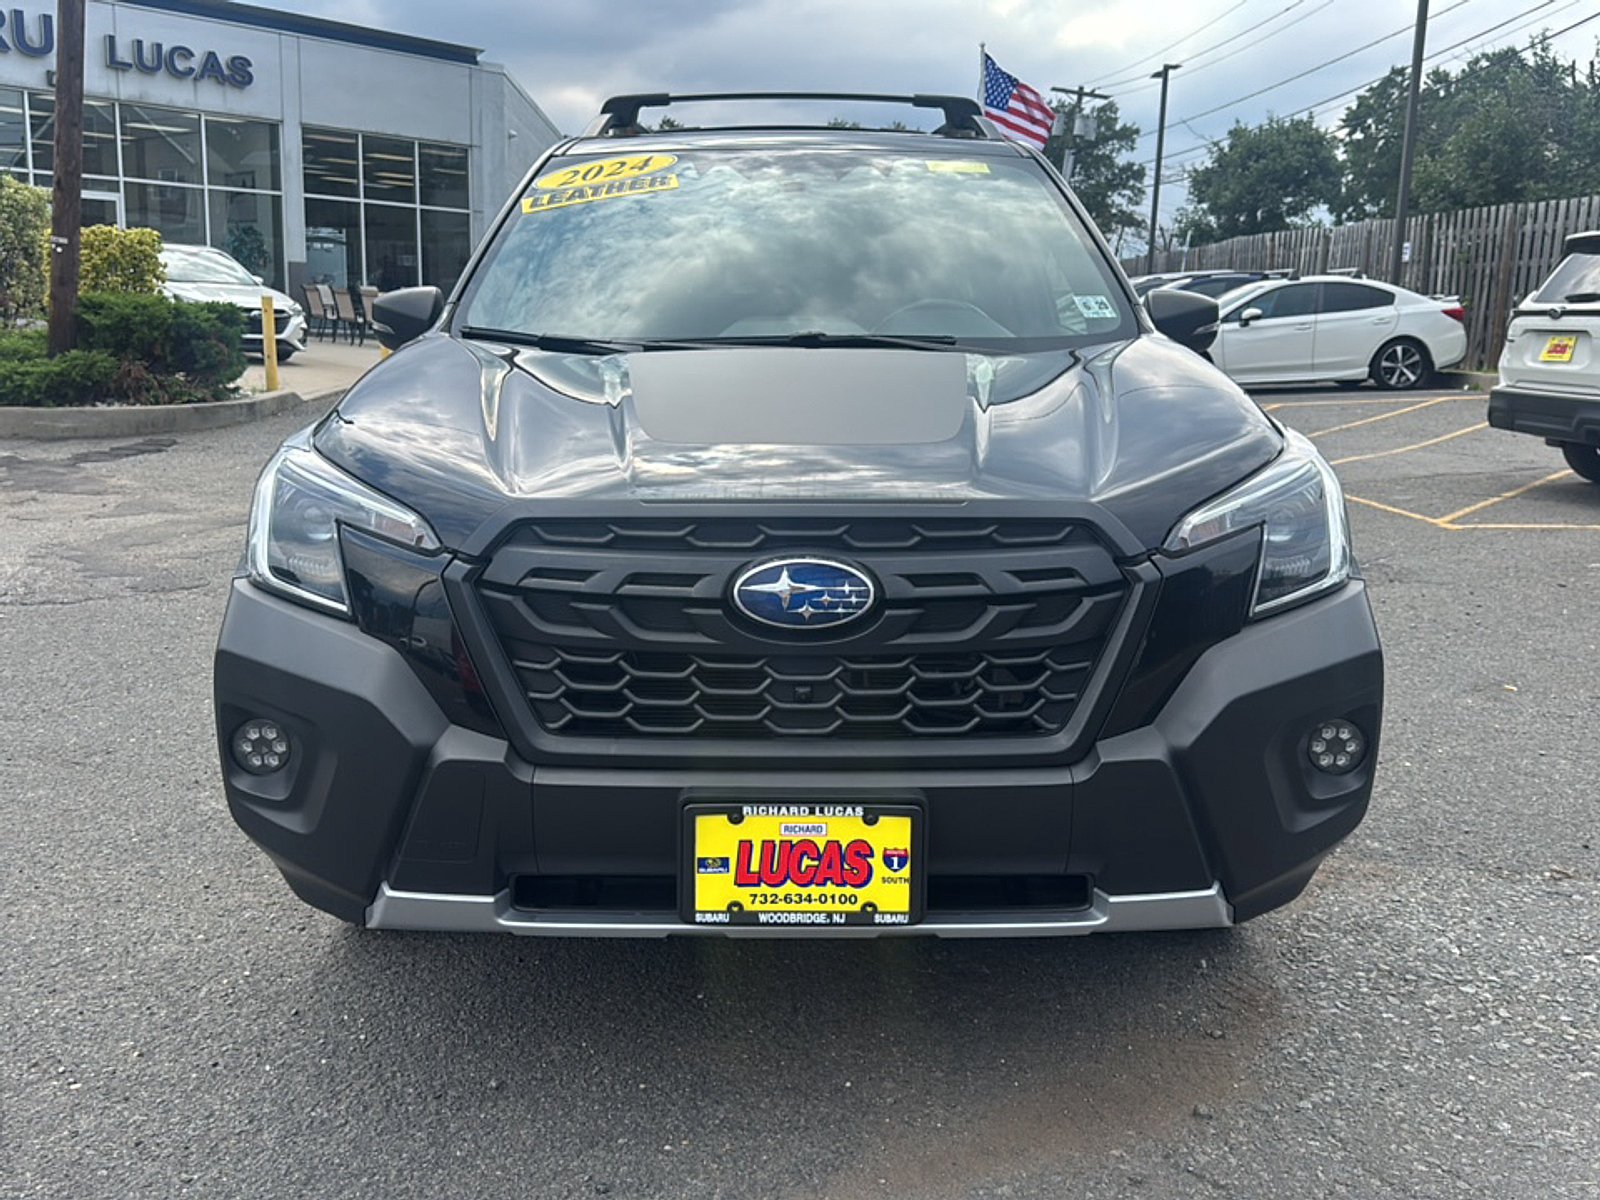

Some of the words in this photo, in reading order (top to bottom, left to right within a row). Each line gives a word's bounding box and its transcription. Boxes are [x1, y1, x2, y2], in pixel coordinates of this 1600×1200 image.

[104, 34, 254, 89] LUCAS
[559, 155, 654, 187] 2024
[529, 176, 672, 209] LEATHER
[742, 806, 810, 816] RICHARD
[815, 806, 865, 817] LUCAS
[783, 825, 824, 834] RICHARD
[734, 839, 875, 888] LUCAS
[890, 856, 900, 870] 1
[881, 876, 910, 884] SOUTH
[749, 893, 858, 905] 732-634-0100
[695, 914, 730, 923] SUBARU
[833, 914, 846, 923] NJ
[874, 914, 909, 923] SUBARU
